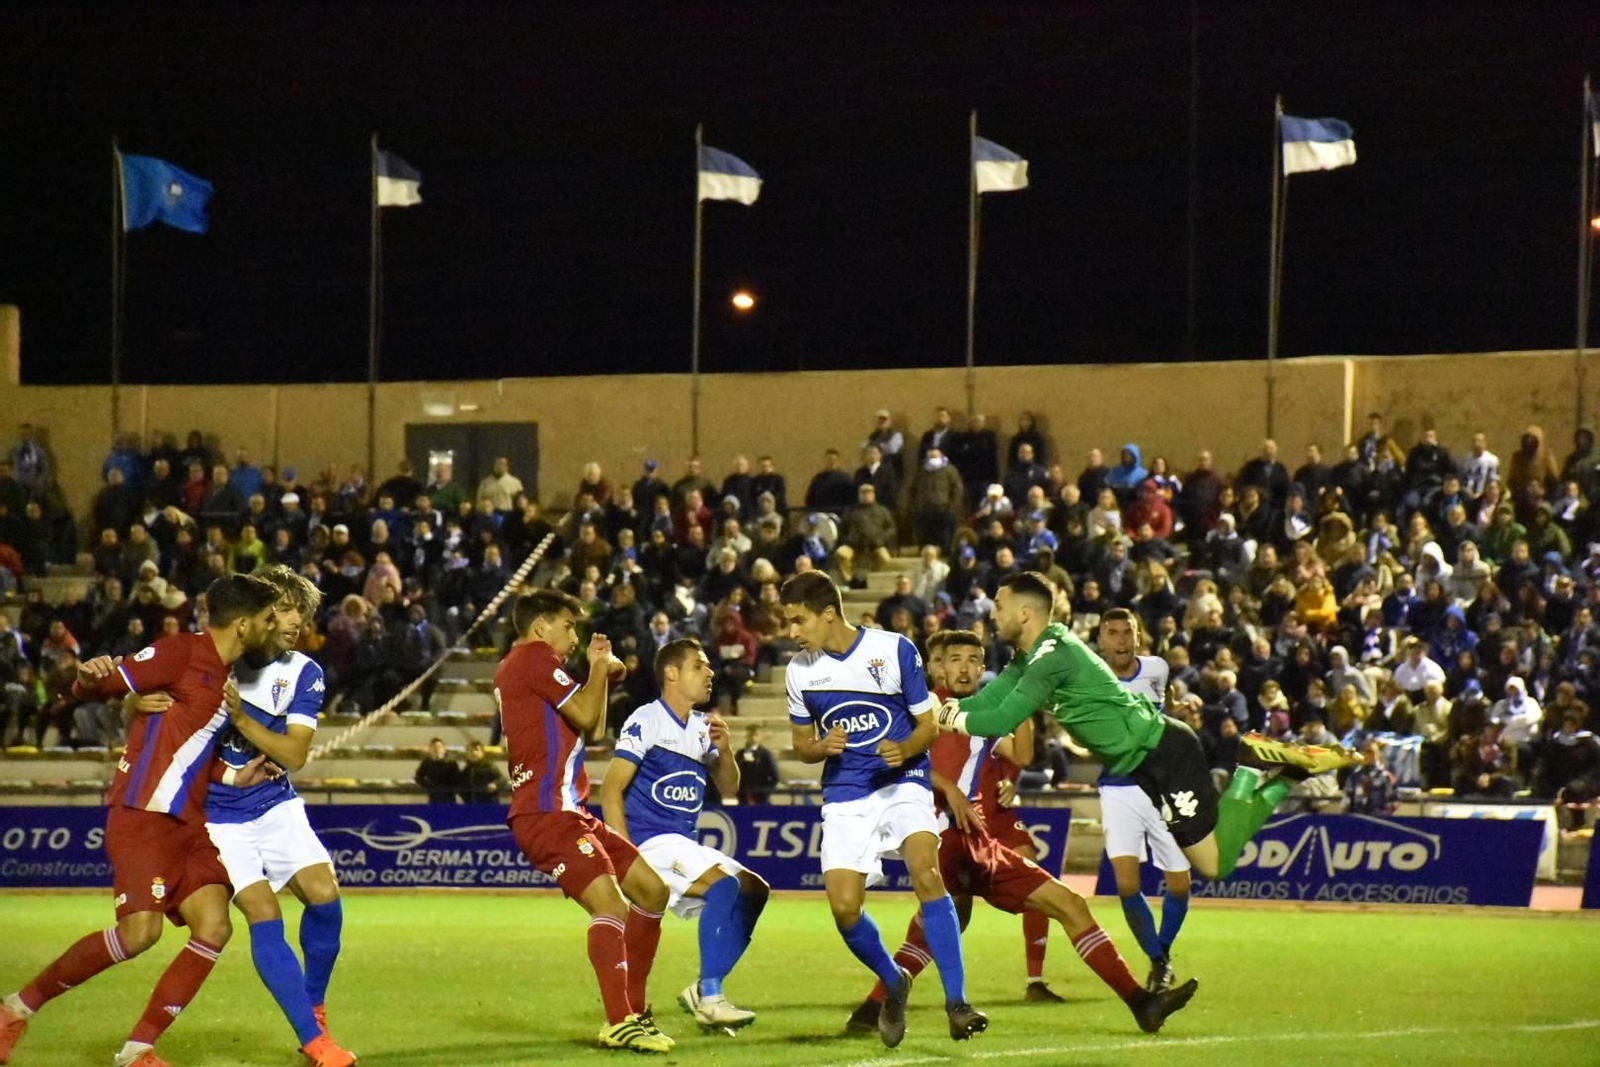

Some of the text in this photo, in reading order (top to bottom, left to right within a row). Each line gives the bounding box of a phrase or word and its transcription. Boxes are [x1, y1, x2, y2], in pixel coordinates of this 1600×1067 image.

[663, 785, 698, 801] COAS
[1157, 880, 1470, 904] RCAMBIOS Y ACCESORIOS
